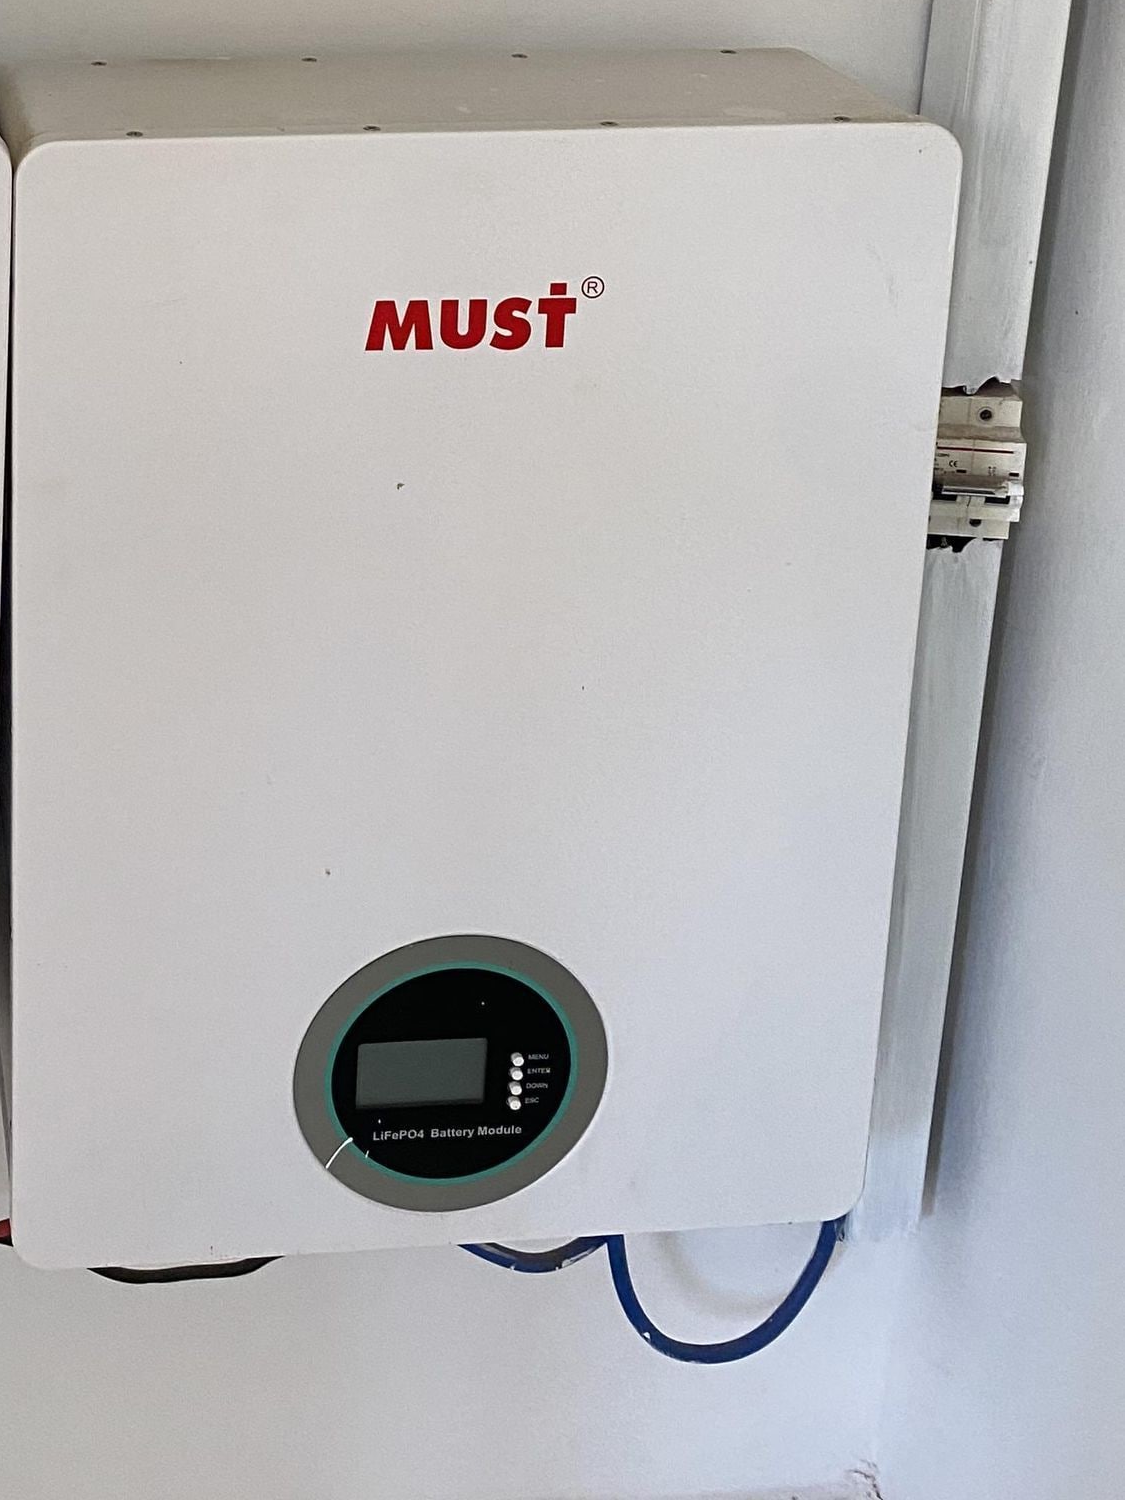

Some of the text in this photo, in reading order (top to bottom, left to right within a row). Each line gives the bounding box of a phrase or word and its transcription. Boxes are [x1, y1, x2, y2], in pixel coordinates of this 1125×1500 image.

[365, 282, 577, 350] MUST
[373, 1125, 523, 1141] LiFePO4 Battery Module
